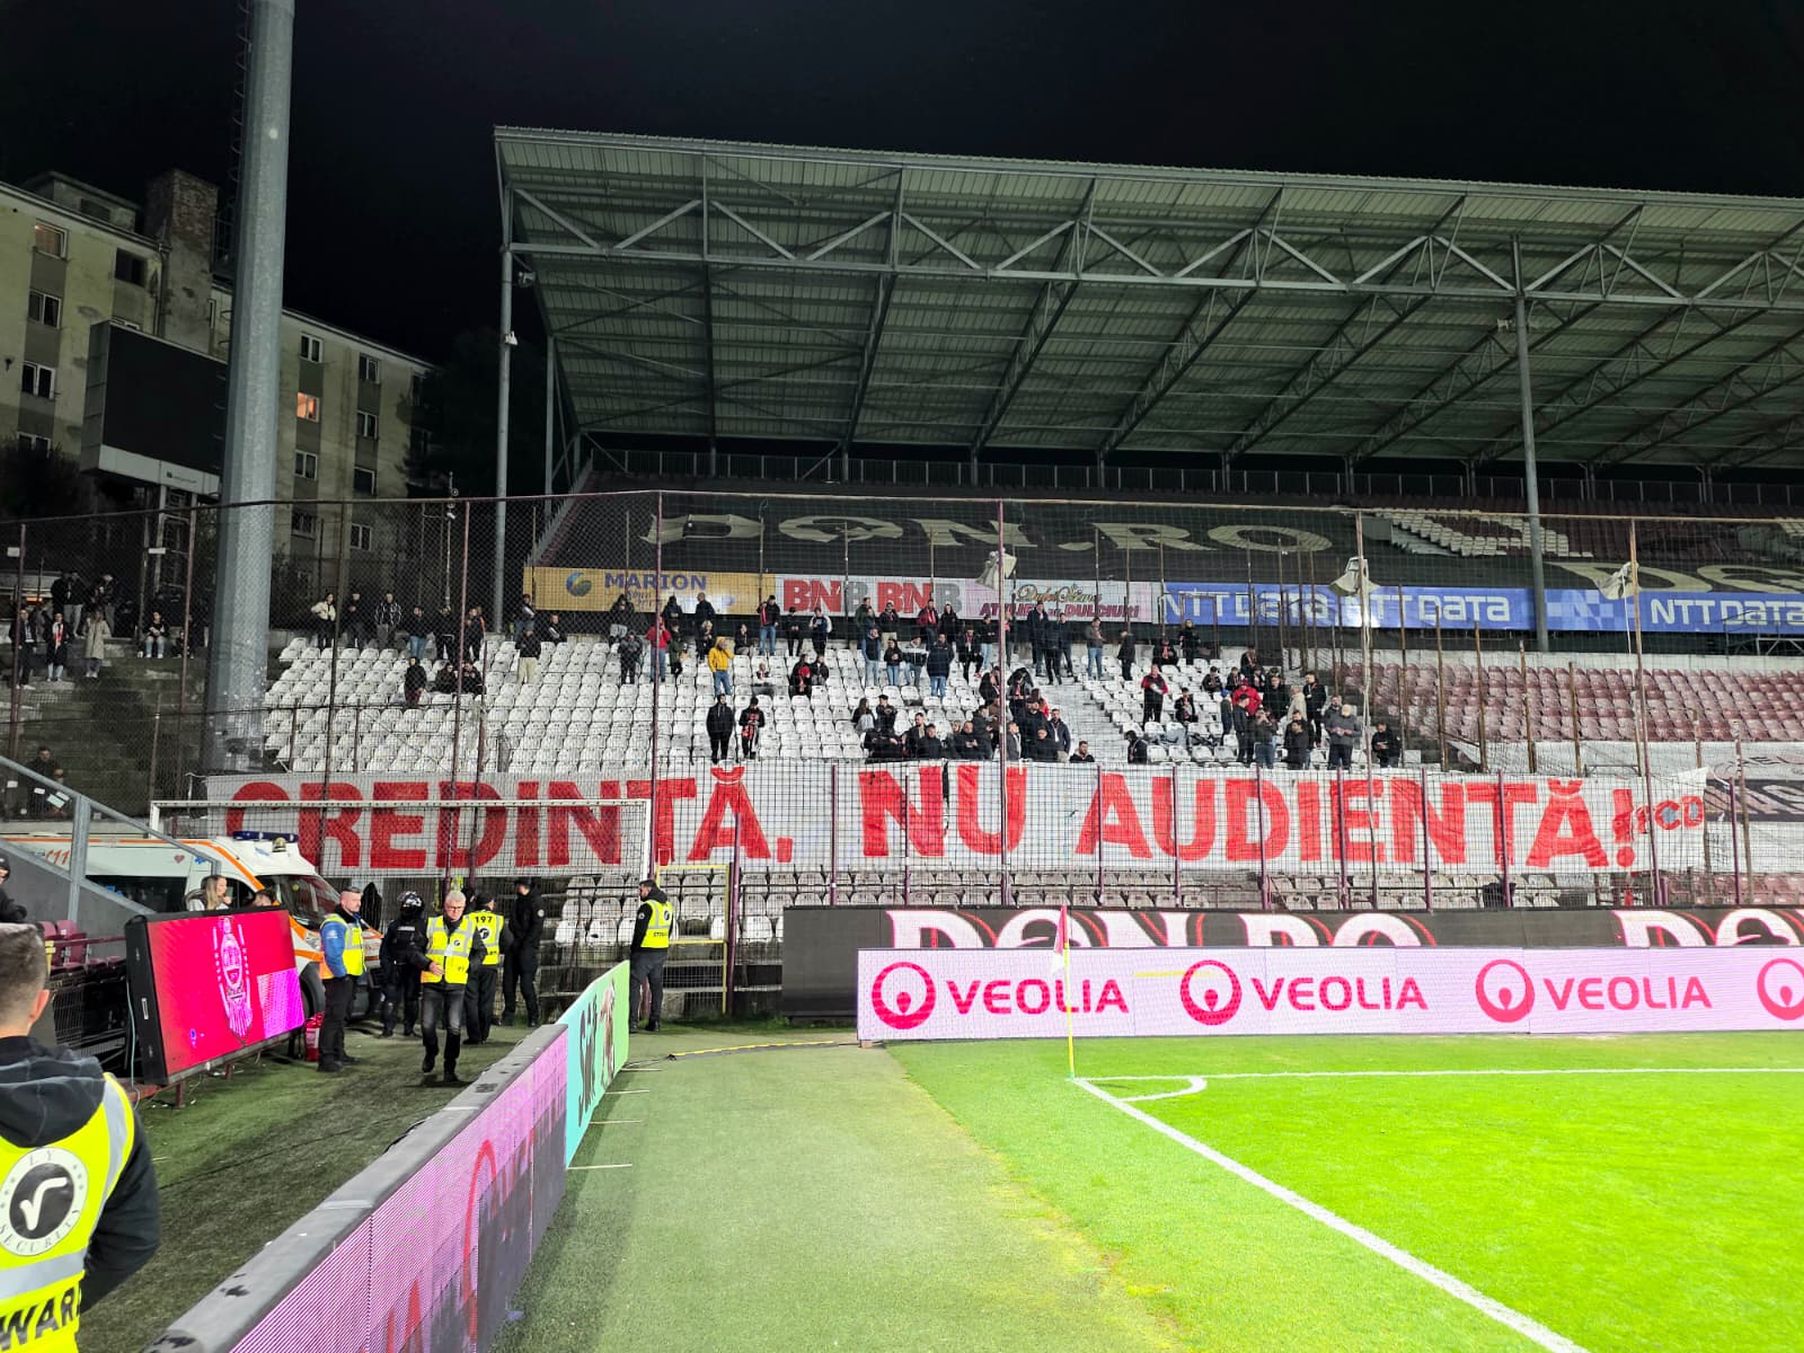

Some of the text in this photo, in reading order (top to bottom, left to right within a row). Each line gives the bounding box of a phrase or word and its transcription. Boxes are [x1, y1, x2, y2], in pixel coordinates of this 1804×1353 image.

[604, 572, 707, 591] MARION
[1650, 598, 1716, 624] NTT
[858, 764, 1028, 857] NU
[946, 978, 1129, 1015] VEOLIA
[1250, 976, 1428, 1011] VEOLIA
[1542, 976, 1713, 1010] VEOLIA
